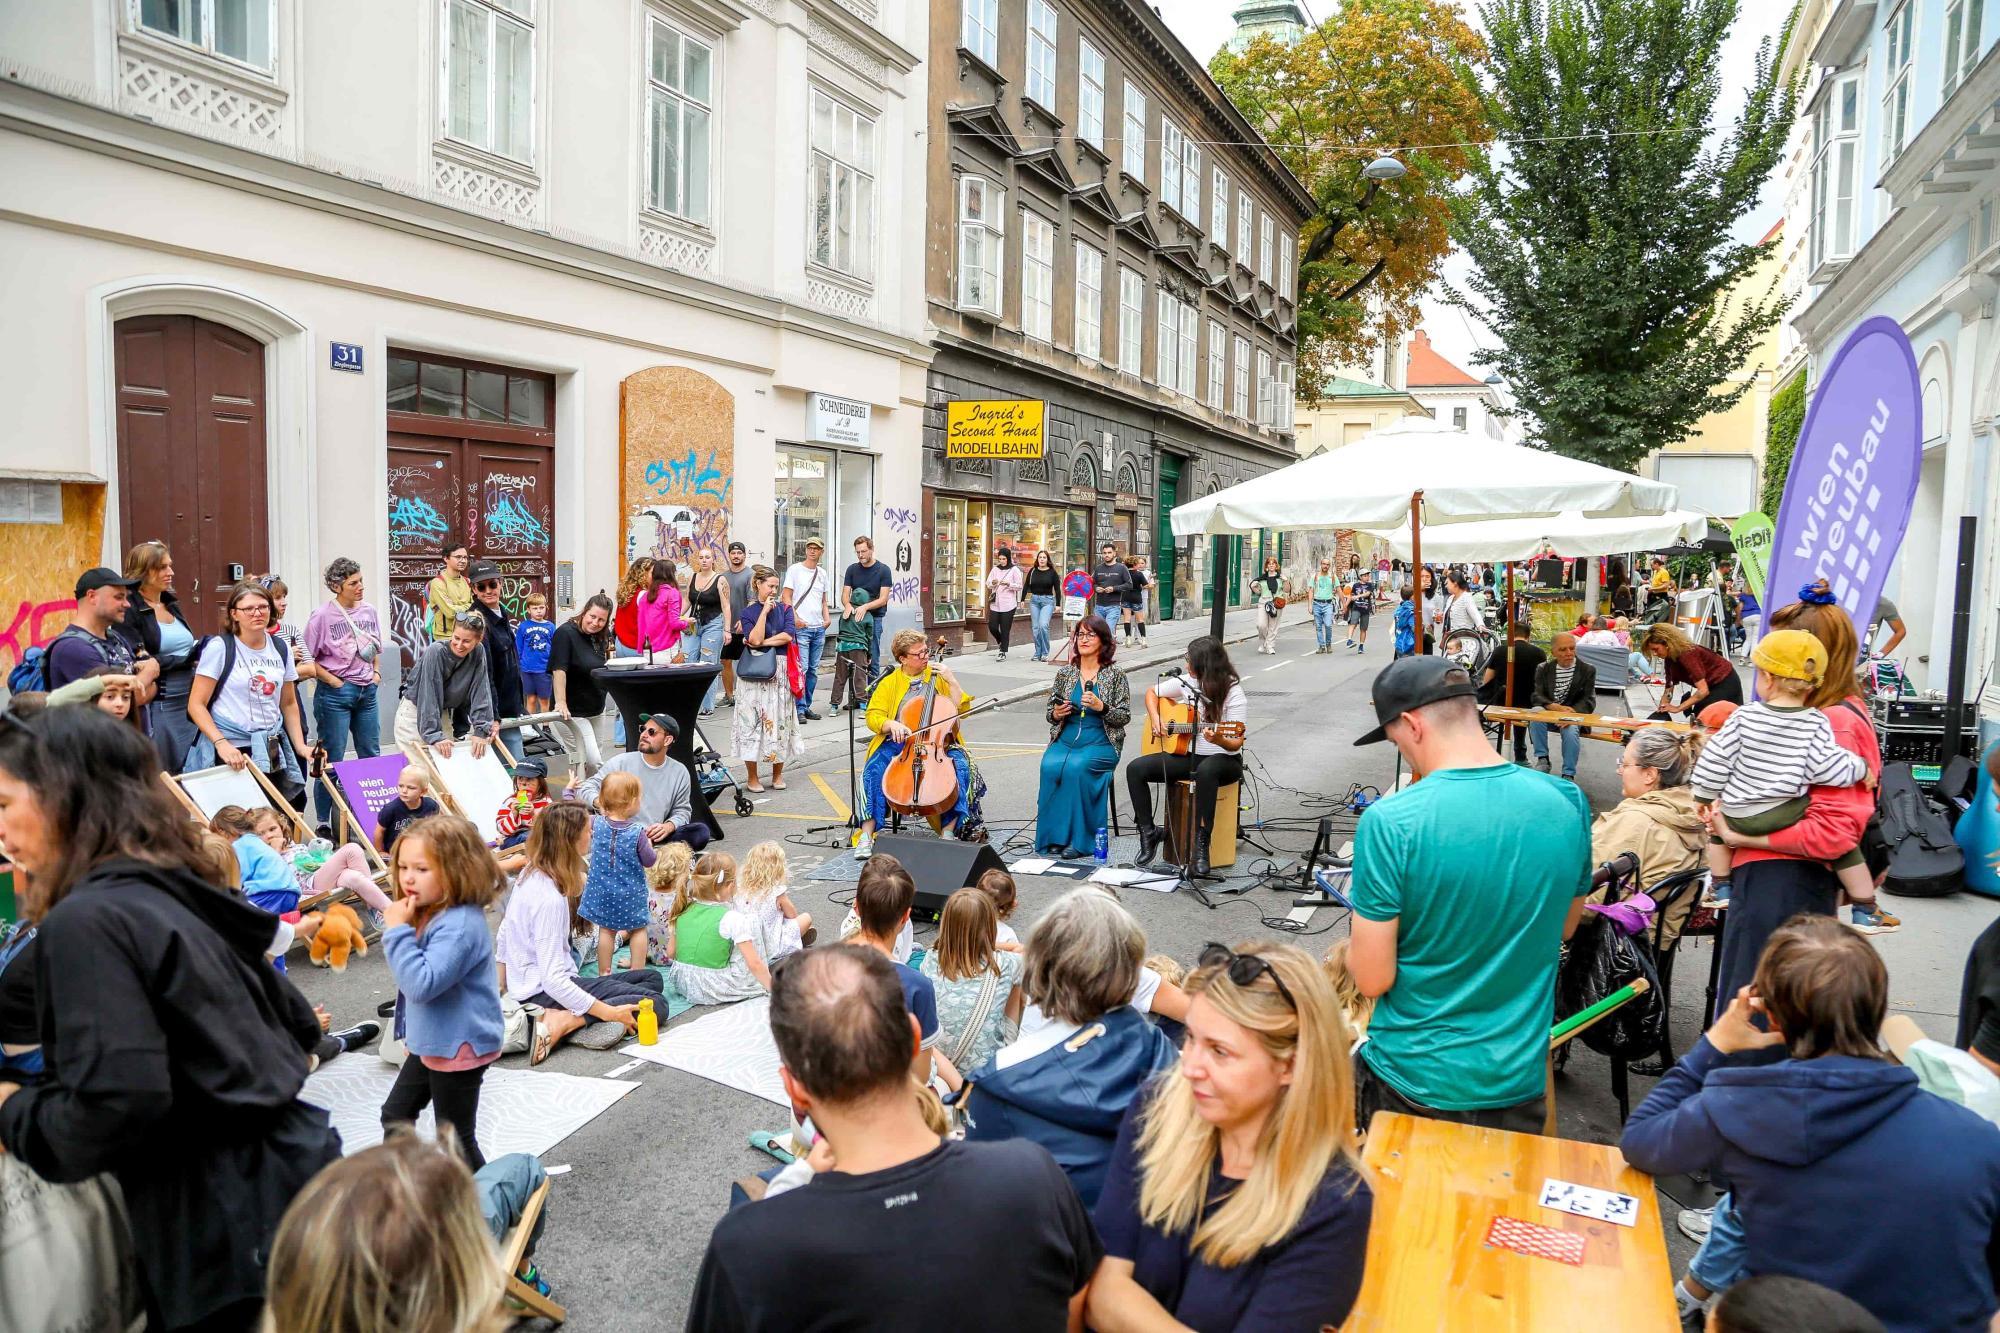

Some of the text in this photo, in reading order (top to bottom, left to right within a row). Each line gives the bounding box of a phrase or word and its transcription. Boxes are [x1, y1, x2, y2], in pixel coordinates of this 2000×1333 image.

[337, 346, 357, 363] 31
[819, 398, 866, 418] SCHNEIDEREI
[966, 404, 1024, 424] Ingrid's
[950, 421, 1040, 437] Second Hand
[950, 442, 1039, 455] MODELLBAHN
[1814, 397, 1891, 581] neubau
[1794, 442, 1849, 560] wien
[358, 778, 385, 788] wien
